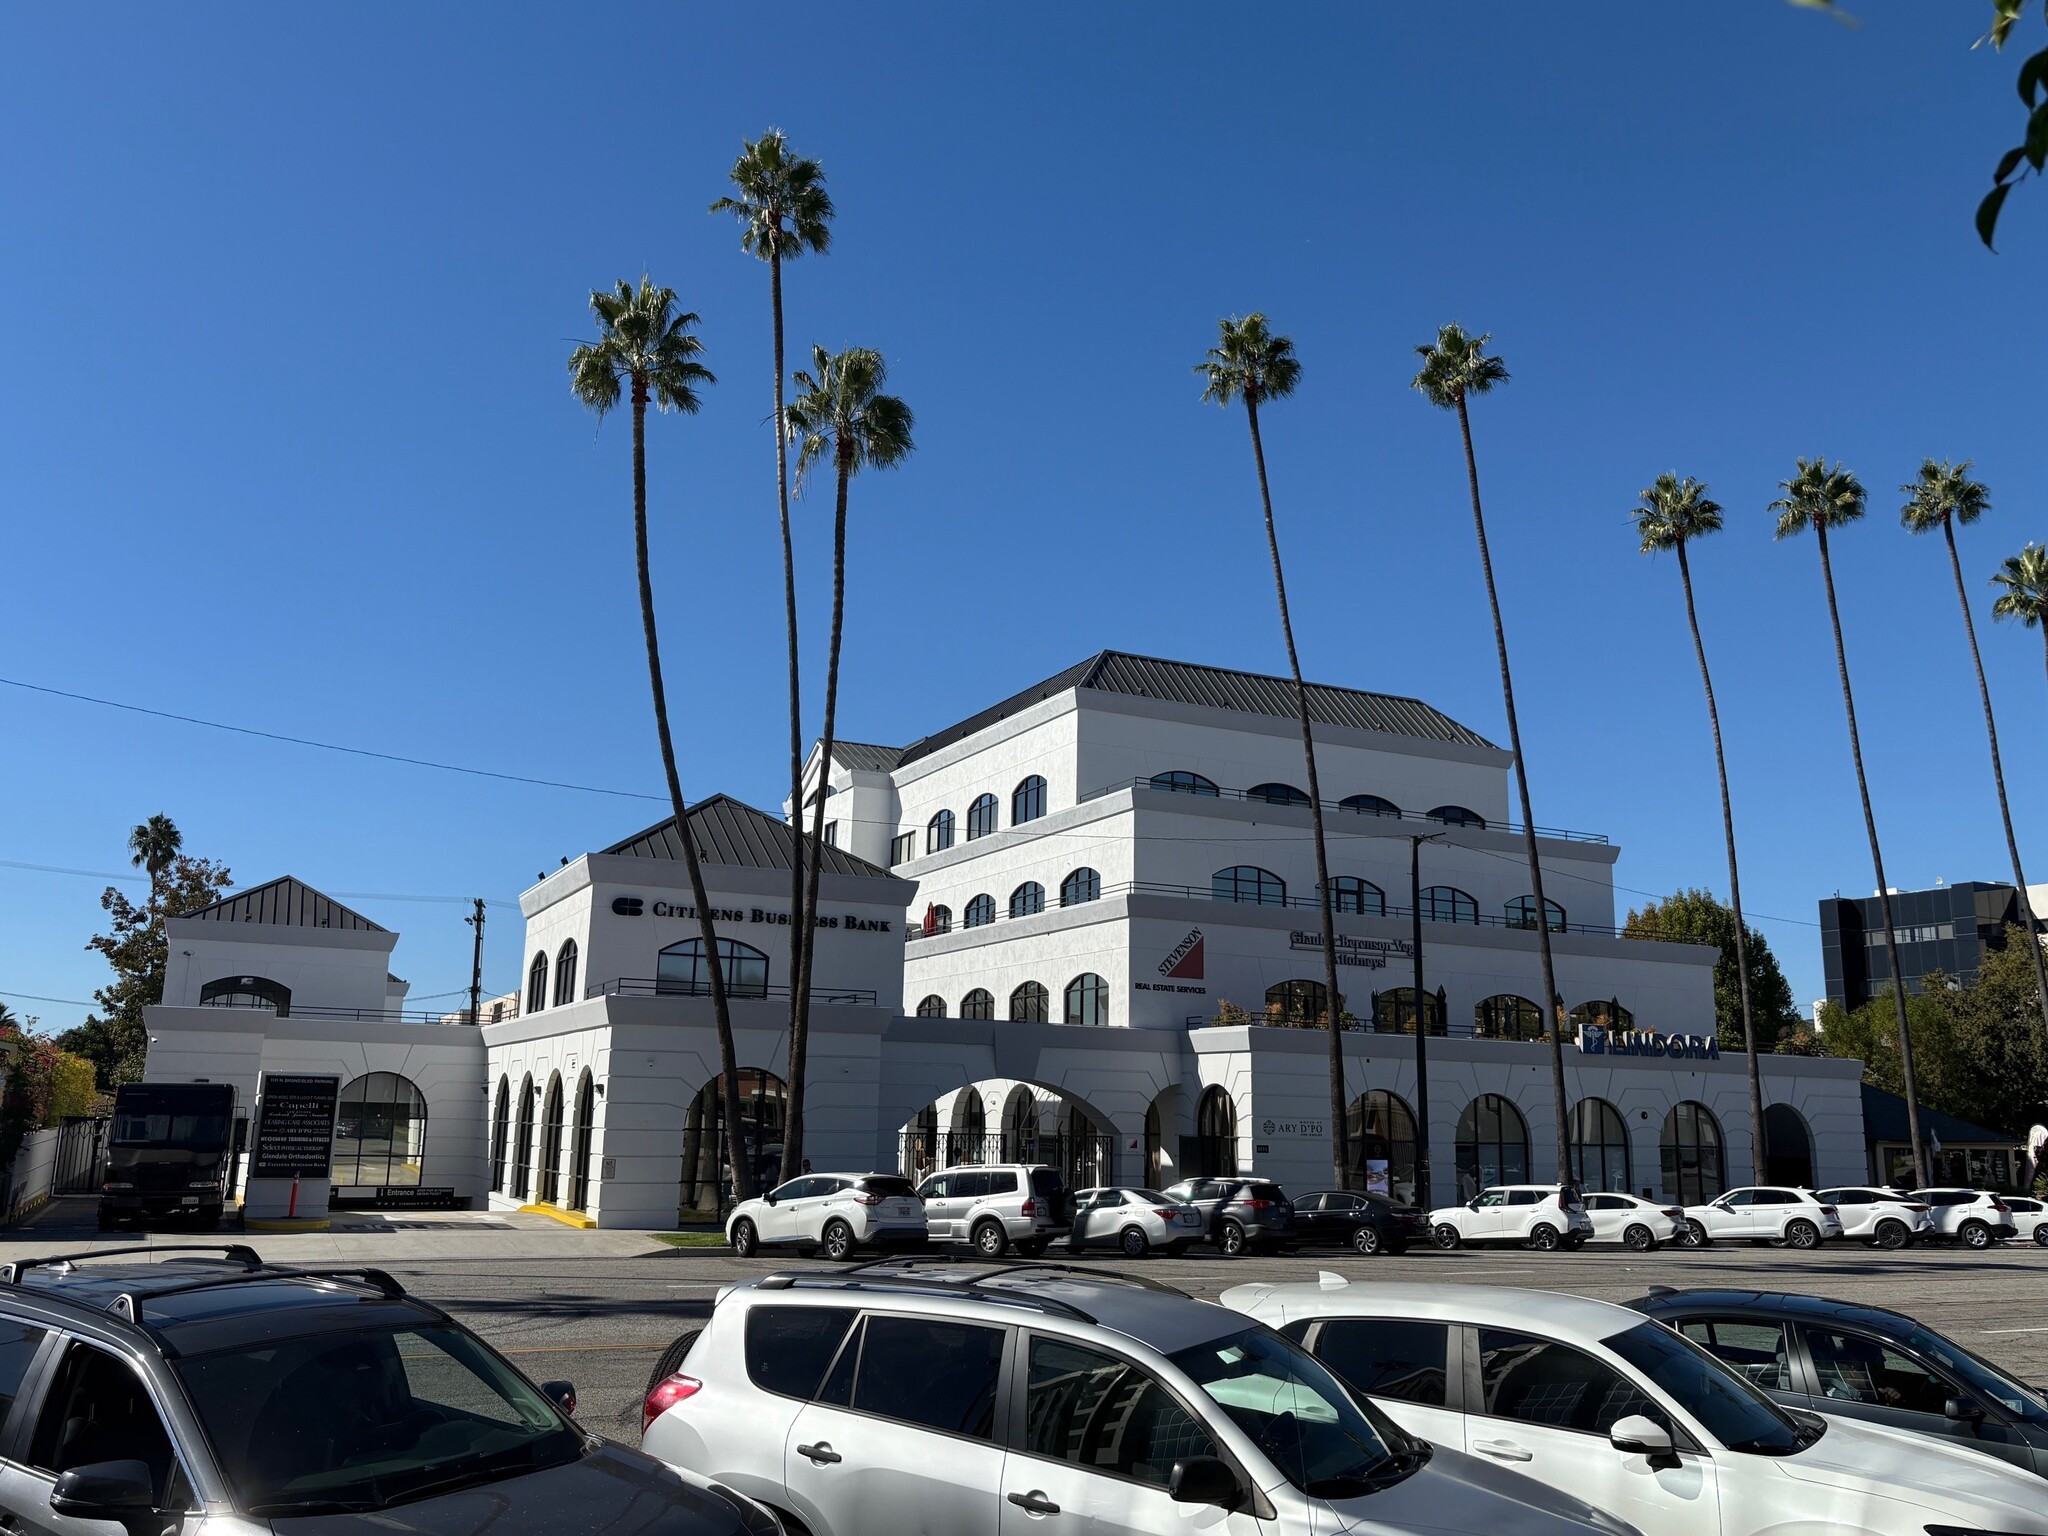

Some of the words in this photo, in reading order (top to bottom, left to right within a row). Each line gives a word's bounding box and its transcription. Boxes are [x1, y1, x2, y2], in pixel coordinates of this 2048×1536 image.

[652, 901, 743, 922] CITIENS
[750, 908, 838, 929] BUSISS
[844, 915, 891, 932] BANK
[1157, 926, 1203, 977] STEVENSON
[1392, 939, 1414, 957] Veg
[1134, 982, 1152, 991] REAL
[1152, 983, 1176, 993] ESTATE
[1176, 985, 1207, 995] SERVICES
[1608, 1030, 1720, 1060] LINDORA
[279, 1101, 319, 1110] Capelli
[1278, 1123, 1298, 1133] ARY
[261, 1143, 281, 1151] Select
[261, 1152, 288, 1160] Glendale
[288, 1153, 326, 1161] Orthodontics
